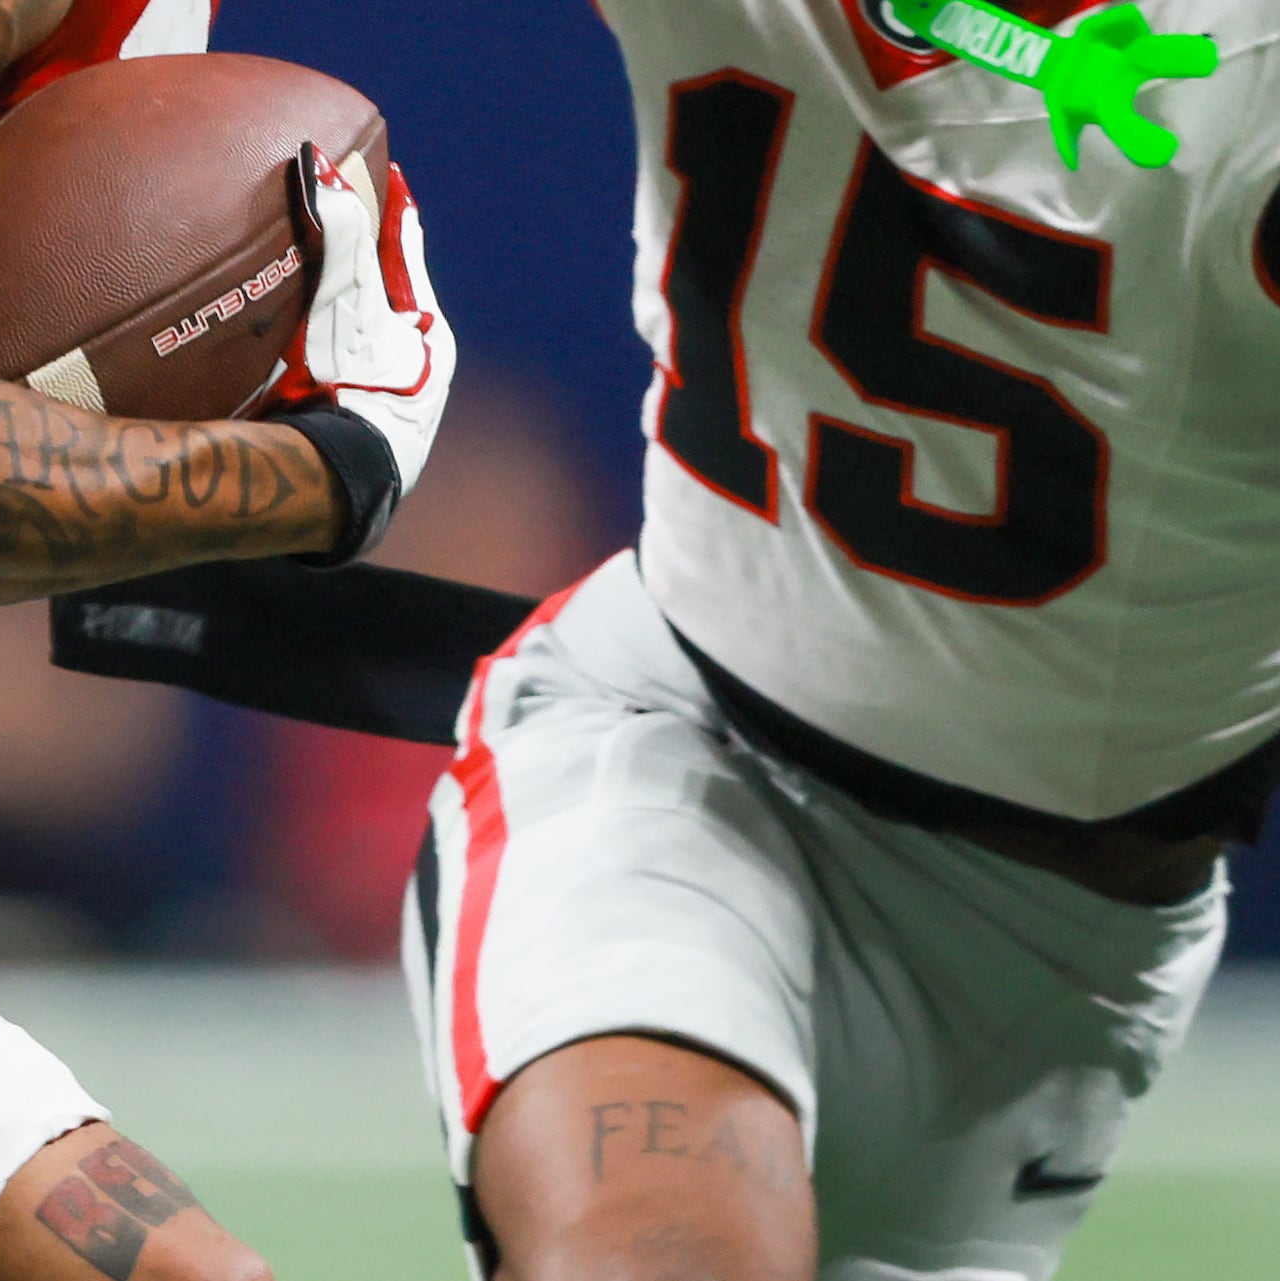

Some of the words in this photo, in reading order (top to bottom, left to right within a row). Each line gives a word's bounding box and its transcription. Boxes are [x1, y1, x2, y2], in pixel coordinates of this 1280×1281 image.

[242, 245, 302, 302] POR
[151, 287, 246, 358] ELITE
[656, 67, 1111, 608] 15
[112, 423, 297, 519] GOD
